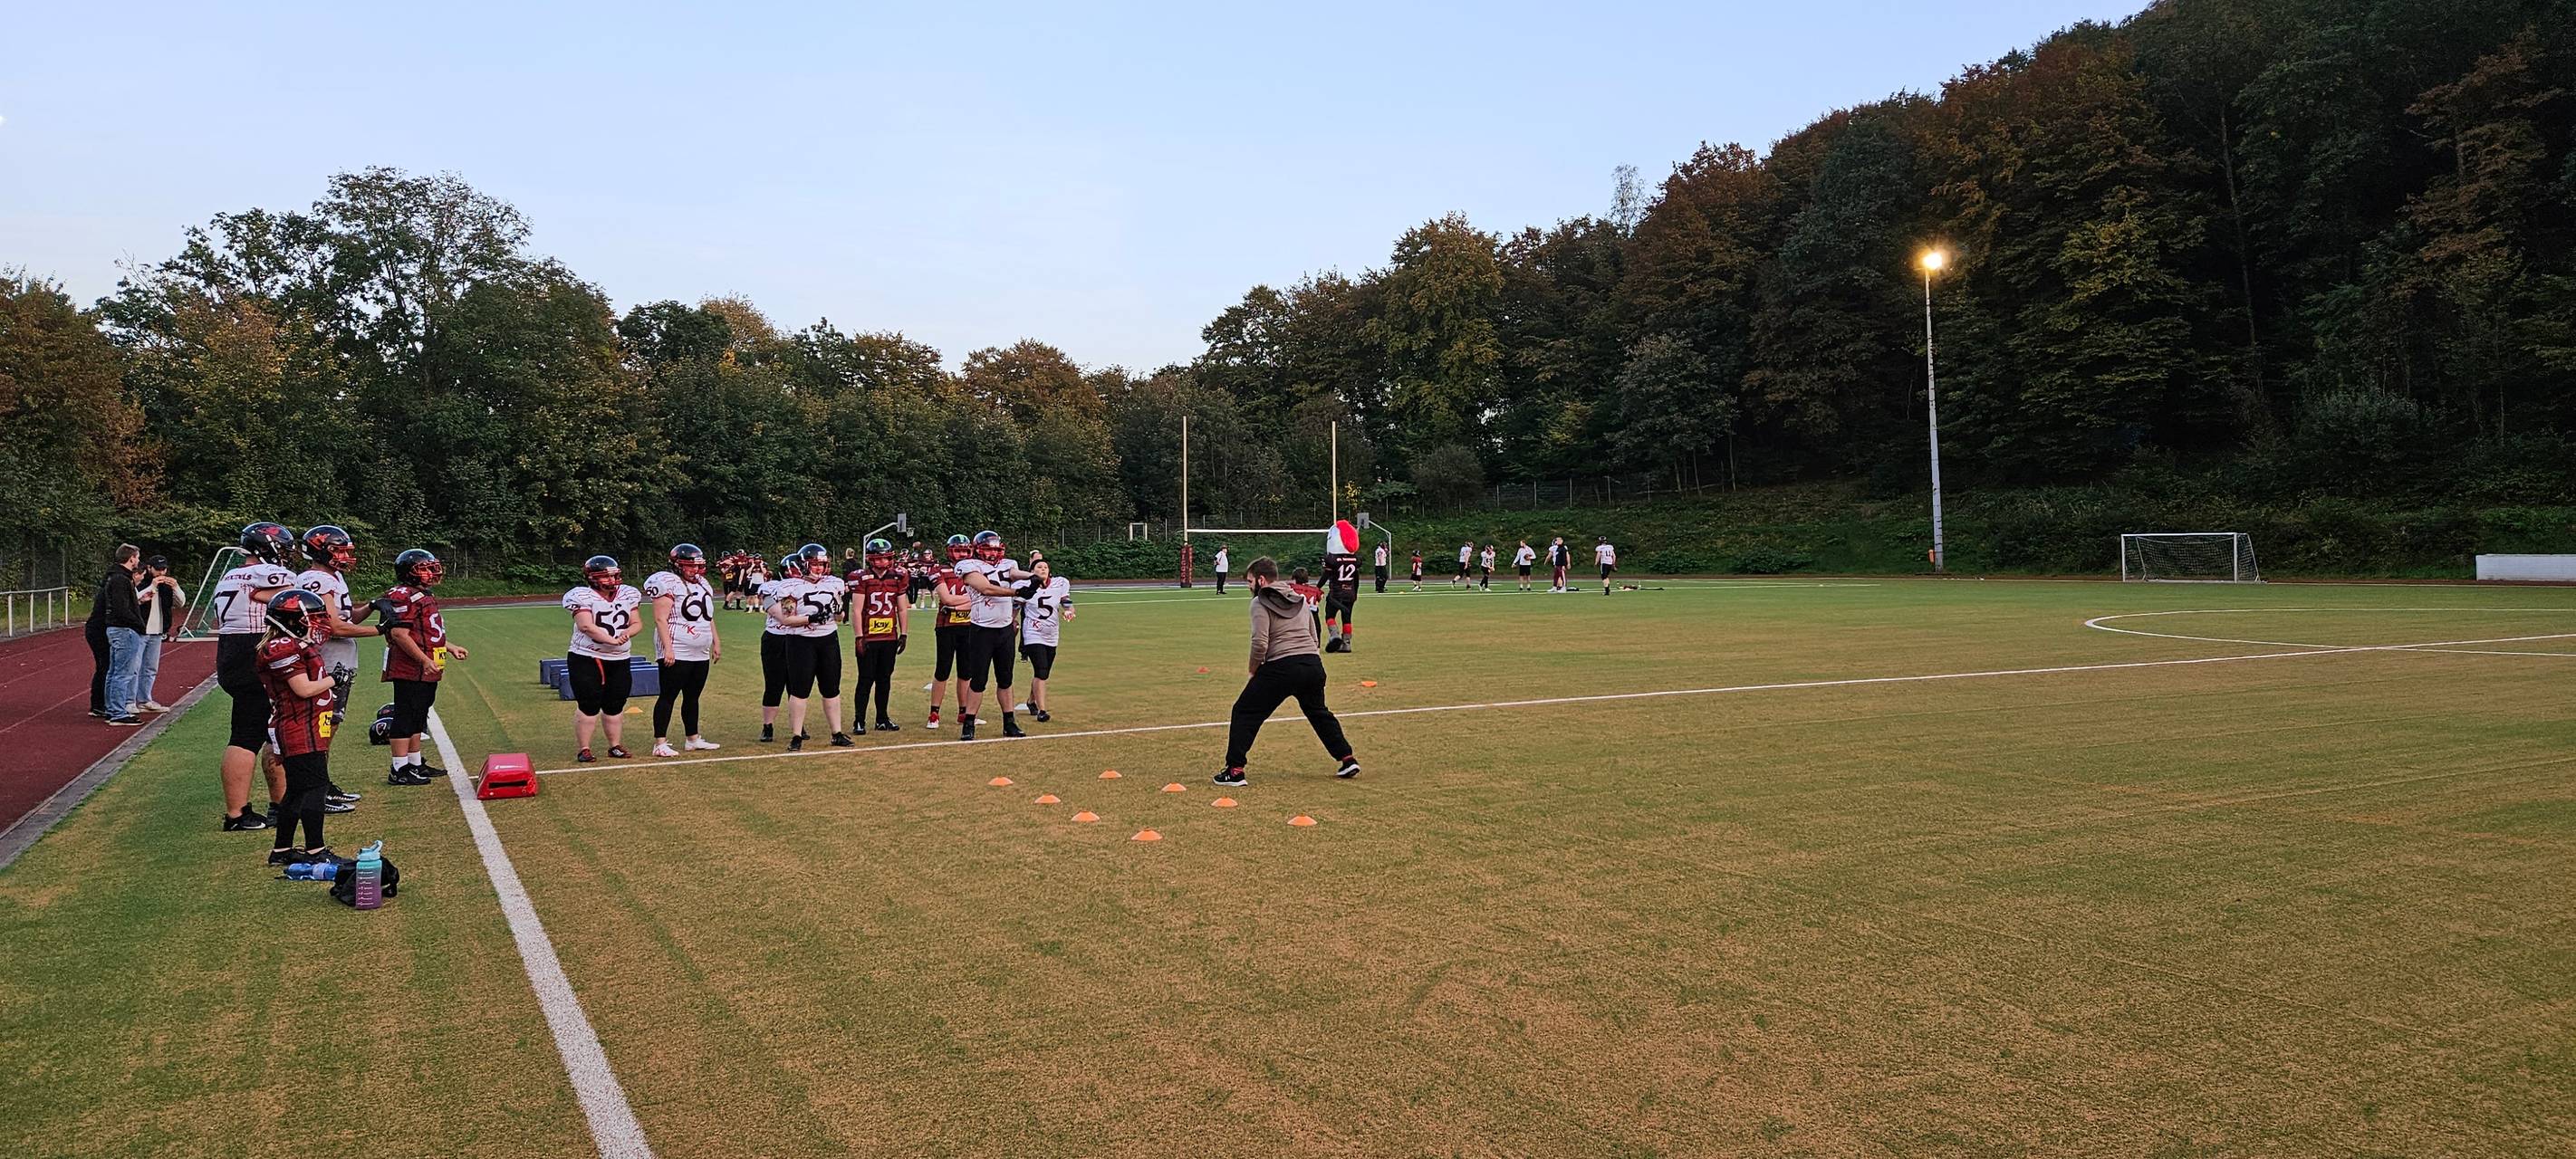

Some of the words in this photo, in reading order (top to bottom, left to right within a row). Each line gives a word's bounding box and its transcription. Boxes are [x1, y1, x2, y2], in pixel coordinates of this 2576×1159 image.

[267, 572, 287, 585] 67
[1337, 563, 1356, 581] 12
[681, 592, 713, 622] 60
[869, 591, 896, 616] 55
[1037, 595, 1053, 620] 5
